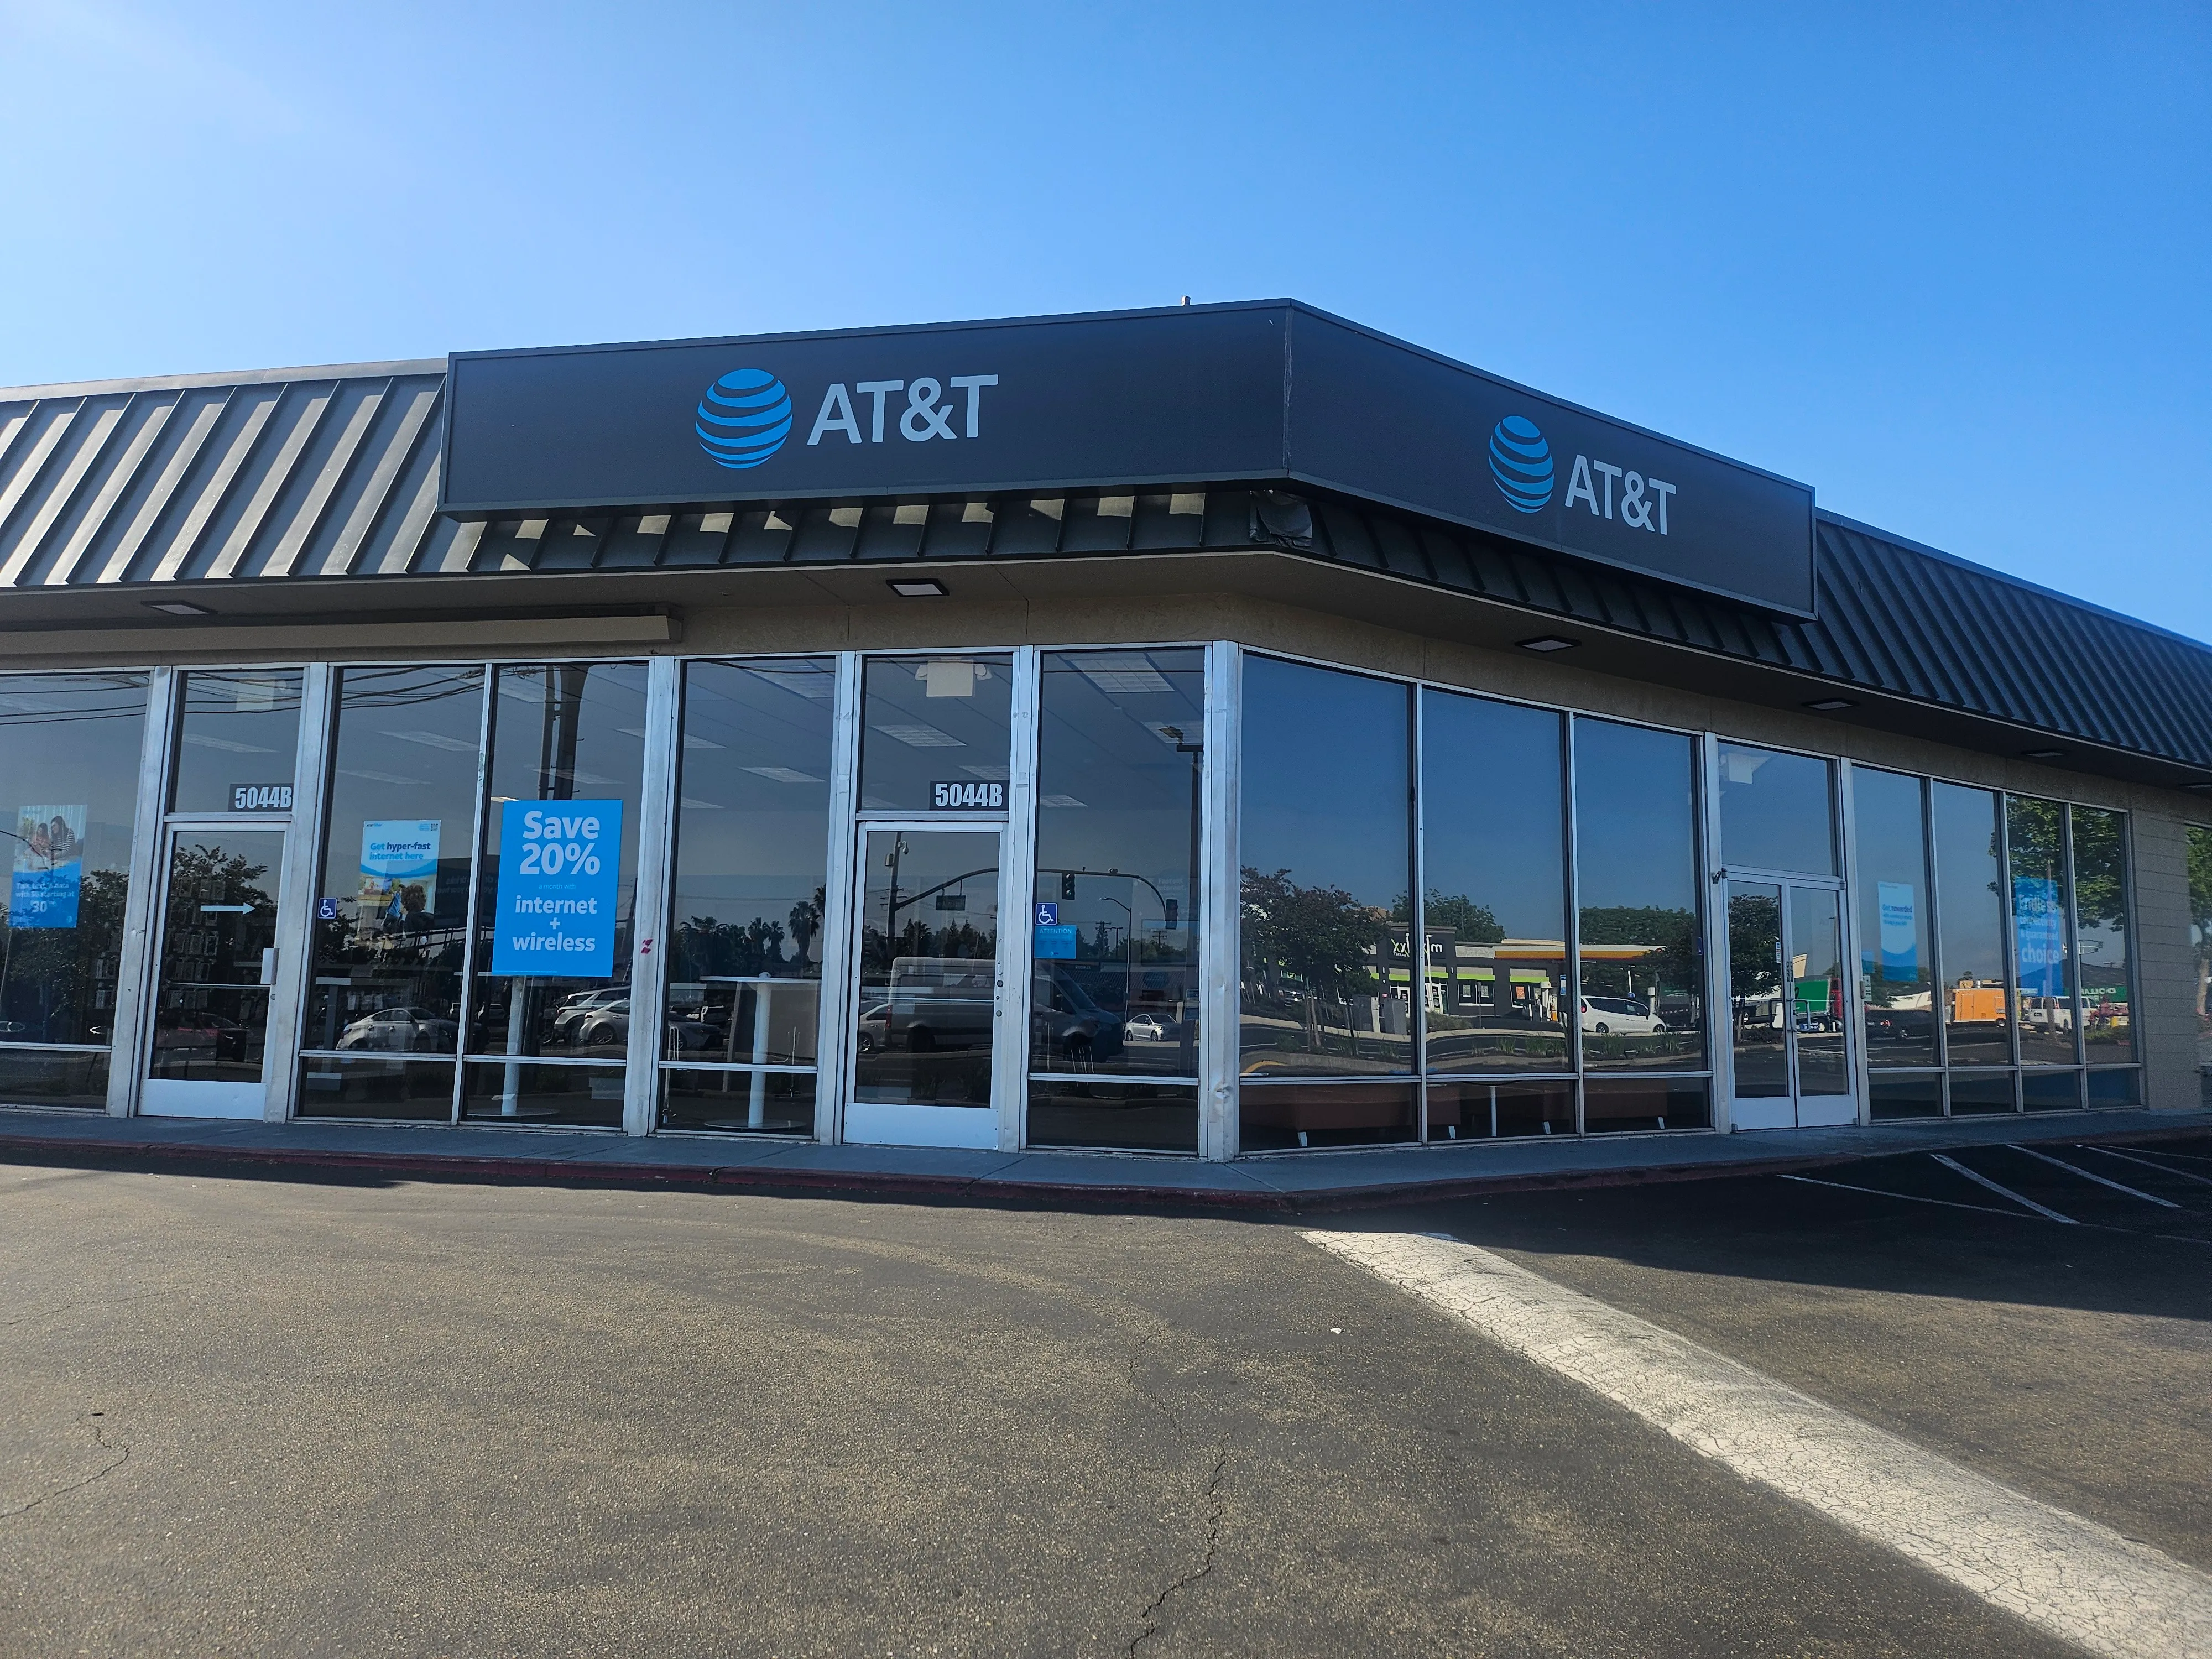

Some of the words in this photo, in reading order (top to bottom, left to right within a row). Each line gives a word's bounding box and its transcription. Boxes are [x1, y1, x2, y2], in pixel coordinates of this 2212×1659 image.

[807, 374, 999, 446] AT&T
[1564, 454, 1677, 535] AT&T
[234, 786, 292, 809] 5044B
[935, 783, 1003, 807] 5044B
[523, 810, 601, 839] Save
[369, 852, 403, 860] internet
[405, 852, 424, 860] here
[387, 842, 431, 852] hyper-fast
[519, 842, 601, 875] 20%
[515, 895, 598, 914] internet
[550, 917, 560, 930] +
[512, 932, 596, 952] wireless
[2021, 942, 2060, 965] choice
